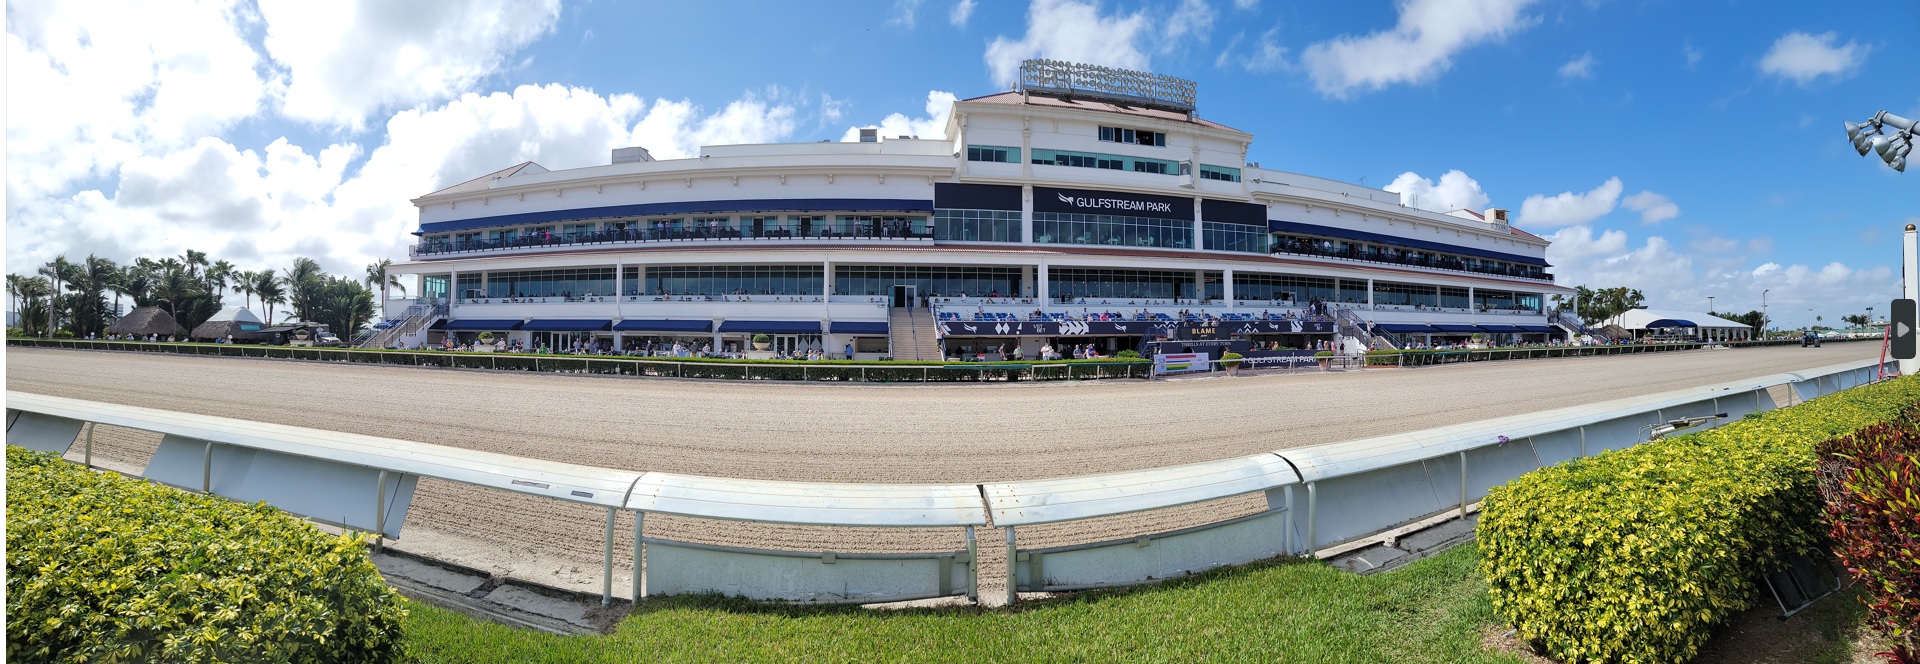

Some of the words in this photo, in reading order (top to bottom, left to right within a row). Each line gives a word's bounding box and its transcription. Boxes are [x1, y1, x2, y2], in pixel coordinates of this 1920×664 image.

[1076, 197, 1145, 211] GULFSTREAM
[1146, 202, 1172, 213] PARK
[1191, 327, 1216, 335] BLAME
[1247, 356, 1298, 364] GULFSTREAM
